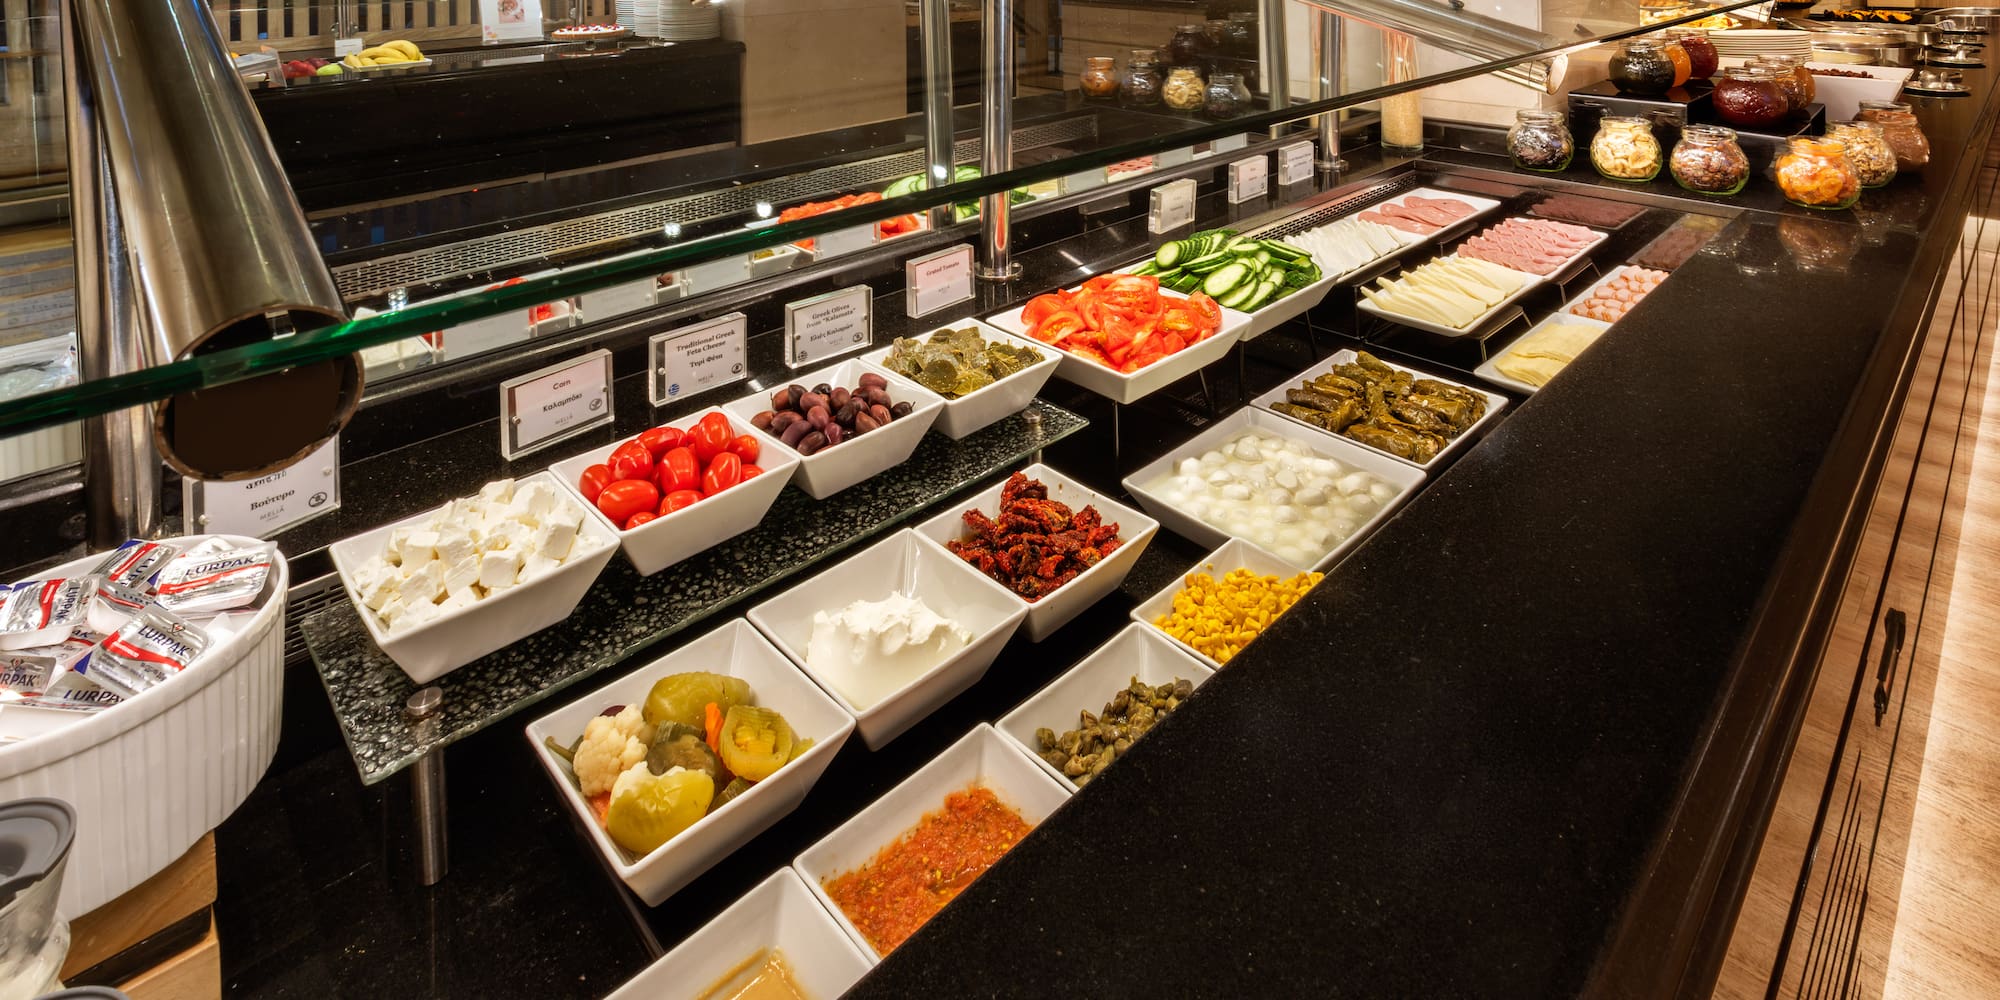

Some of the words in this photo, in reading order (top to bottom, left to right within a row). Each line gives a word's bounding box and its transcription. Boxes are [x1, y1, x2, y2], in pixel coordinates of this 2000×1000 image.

[812, 309, 830, 320] Greek
[831, 304, 850, 313] Olives
[806, 320, 821, 329] from
[676, 335, 715, 352] Traditional
[715, 329, 735, 340] Greek
[686, 347, 702, 357] Feta
[702, 340, 726, 351] Cheese
[552, 379, 571, 390] Corn
[542, 393, 583, 413] Καλαμπόκι
[250, 489, 295, 511] Βούτυρο
[185, 557, 254, 577] LURPAK
[55, 586, 80, 621] LURPAK
[137, 624, 189, 657] LURPAK
[0, 672, 37, 688] RPAK
